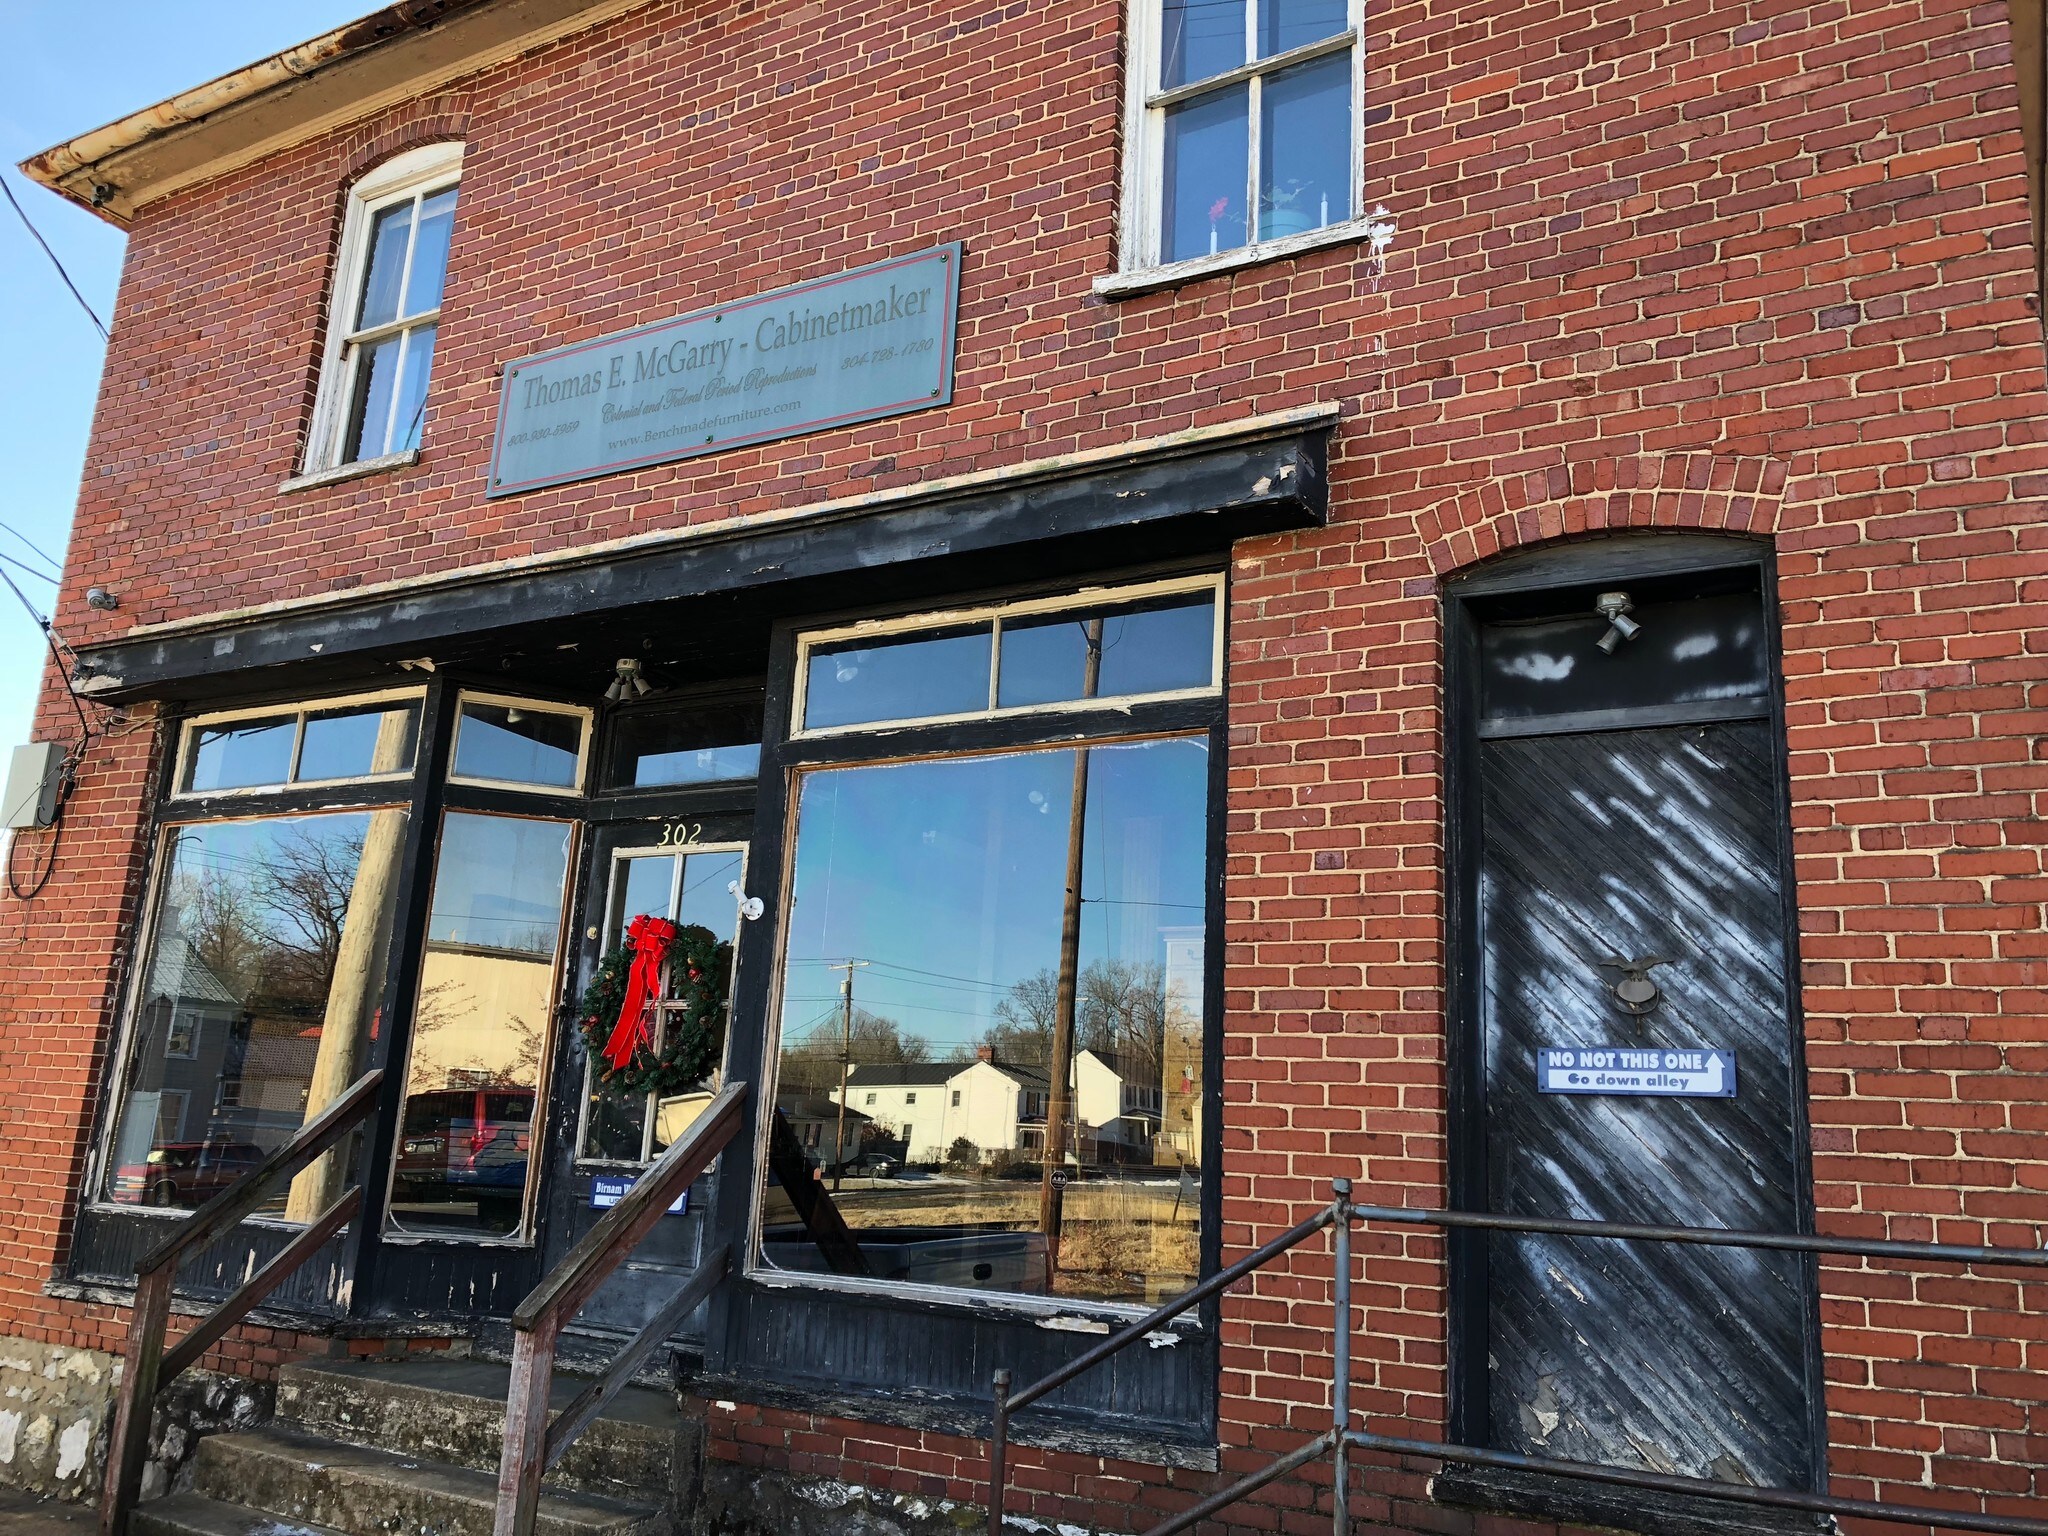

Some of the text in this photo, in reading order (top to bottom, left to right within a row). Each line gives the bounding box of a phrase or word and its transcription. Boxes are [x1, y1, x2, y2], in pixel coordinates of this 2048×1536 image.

[524, 370, 602, 410] Thomas
[607, 355, 626, 389] E.
[632, 337, 734, 384] McGarry
[755, 284, 931, 353] Cabinetmaker
[601, 363, 818, 424] Colonial and Federal Period Reproductions
[608, 400, 802, 450] www.Benchmadefurniture.com
[657, 823, 702, 846] 302
[1549, 1051, 1703, 1070] NO NOT THIS ONE
[1568, 1073, 1690, 1090] Go down alley
[595, 1182, 622, 1194] Birnam
